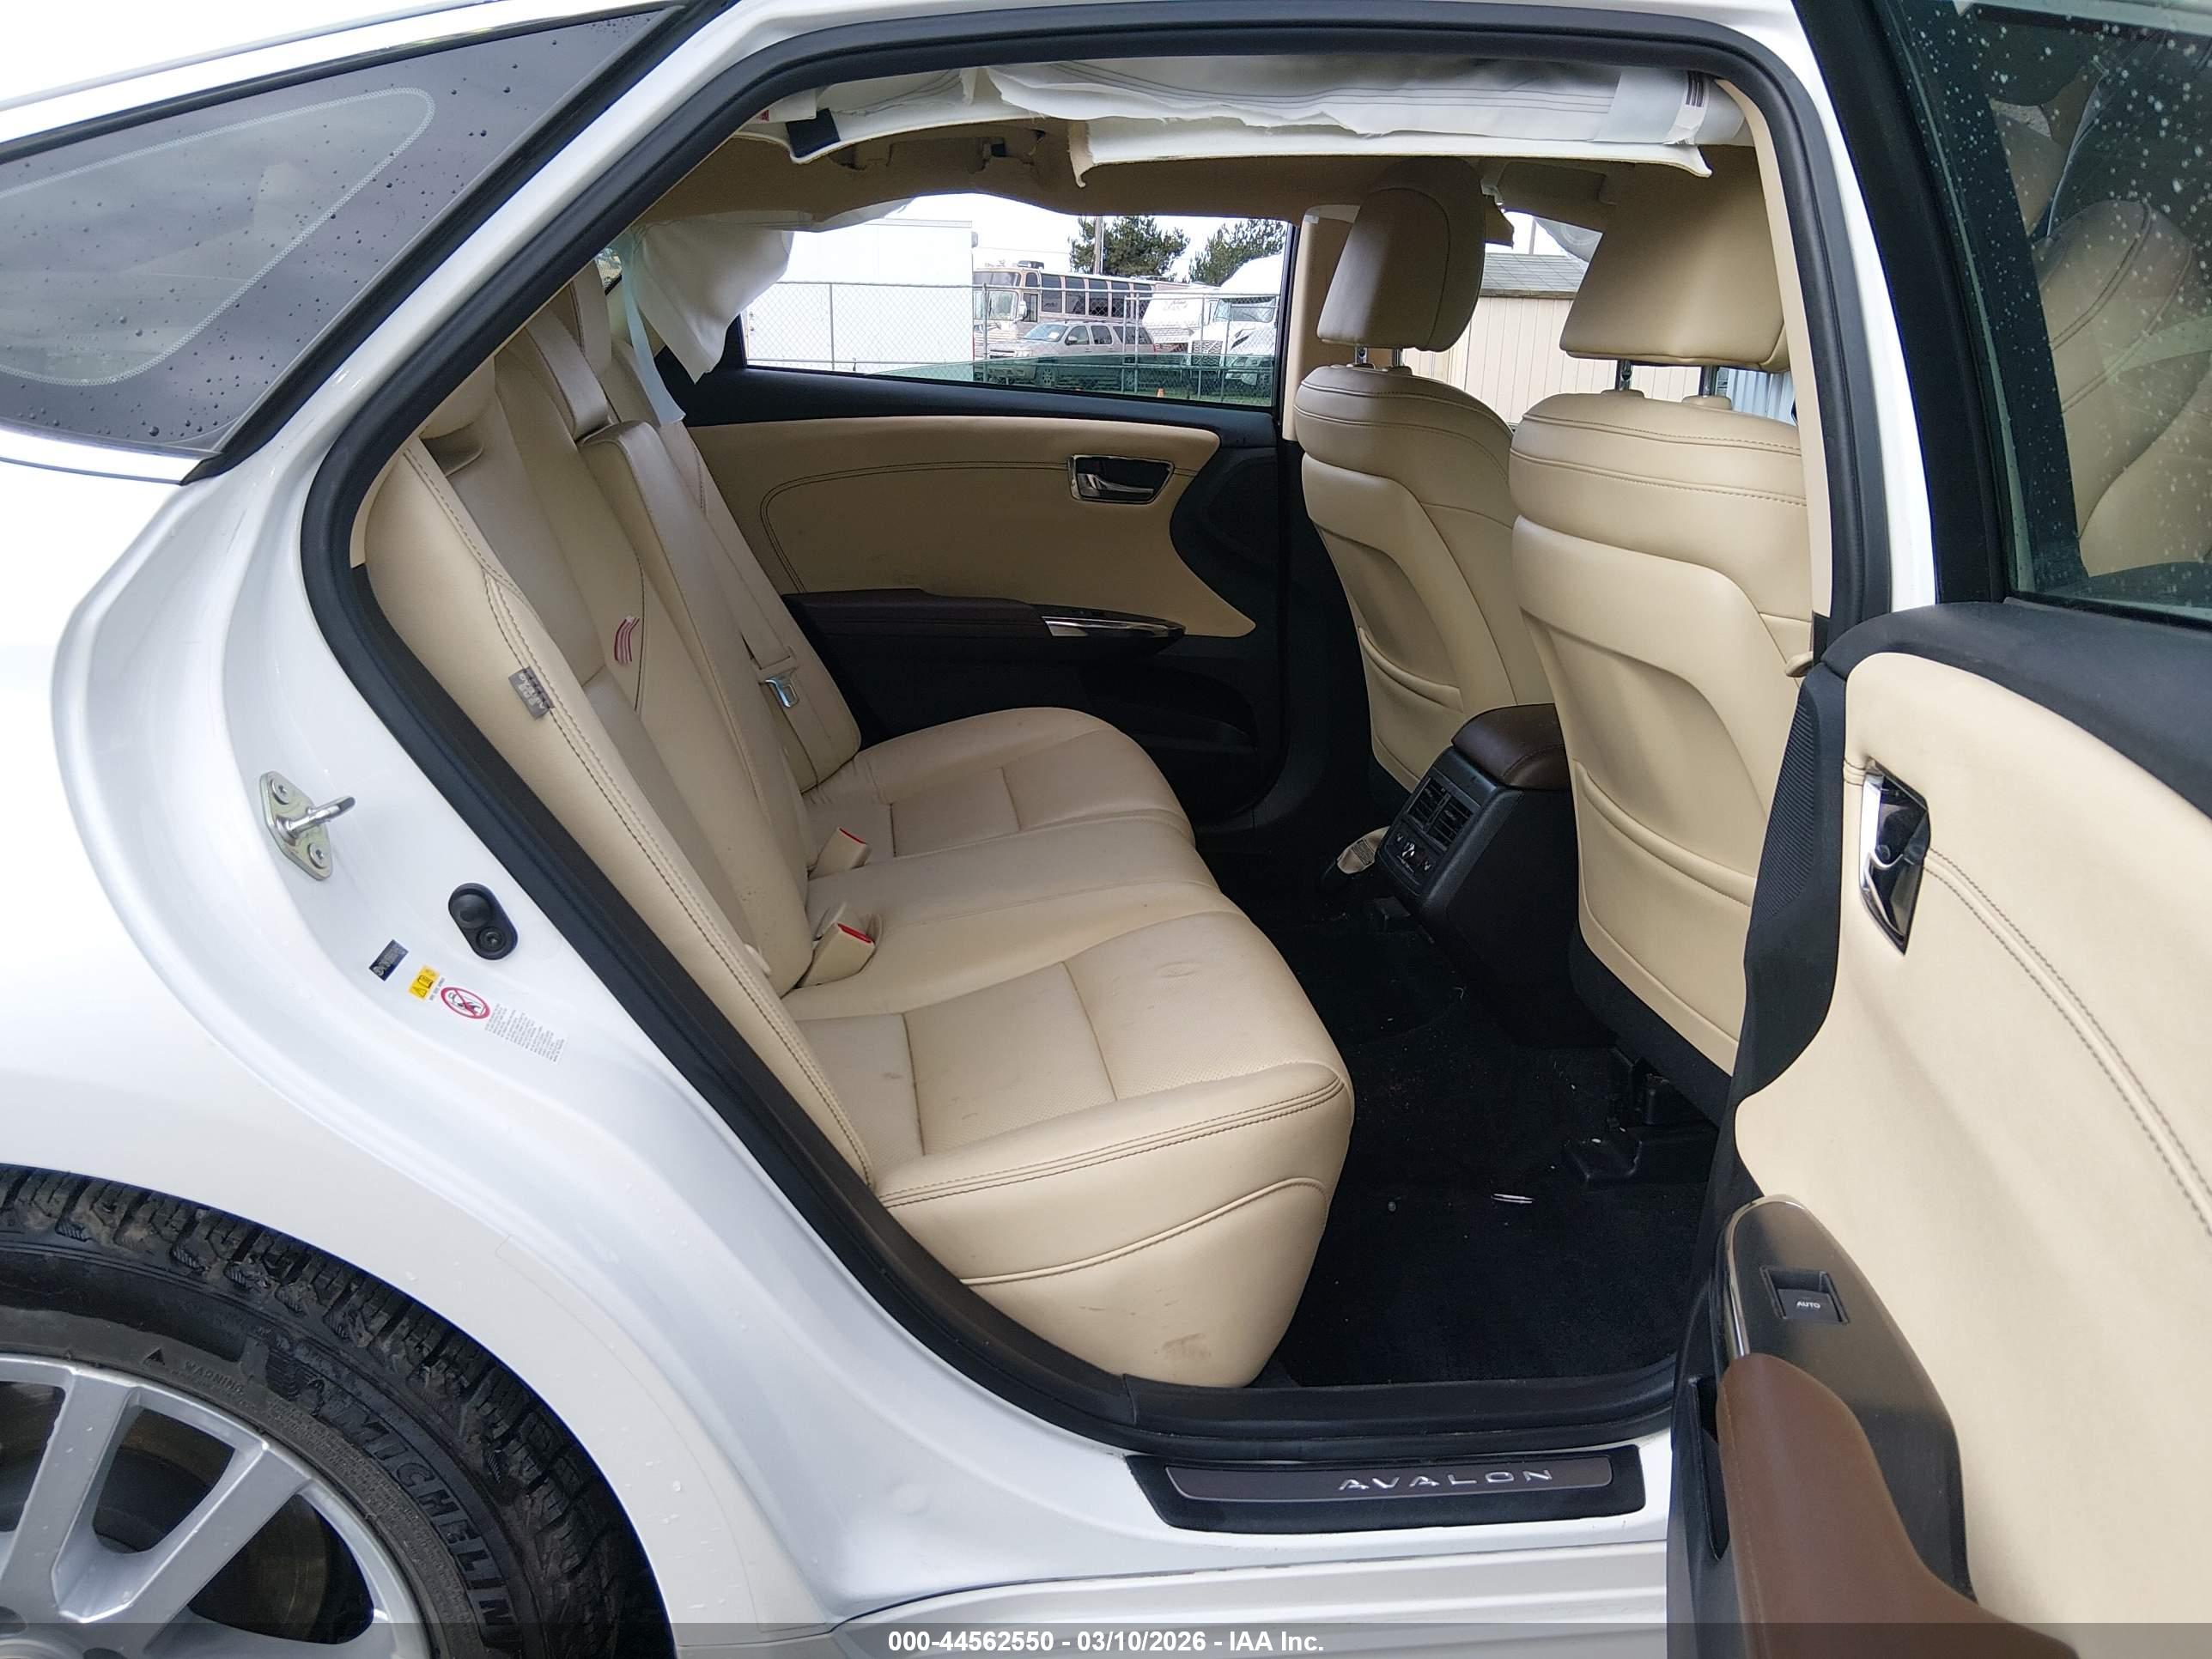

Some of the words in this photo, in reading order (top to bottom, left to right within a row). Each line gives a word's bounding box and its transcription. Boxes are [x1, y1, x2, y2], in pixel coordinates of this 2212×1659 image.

[1796, 1301, 1821, 1310] AUTO
[185, 1360, 243, 1393] WARNING
[1338, 1469, 1553, 1491] AVALON
[335, 1404, 515, 1626] MICHELIN
